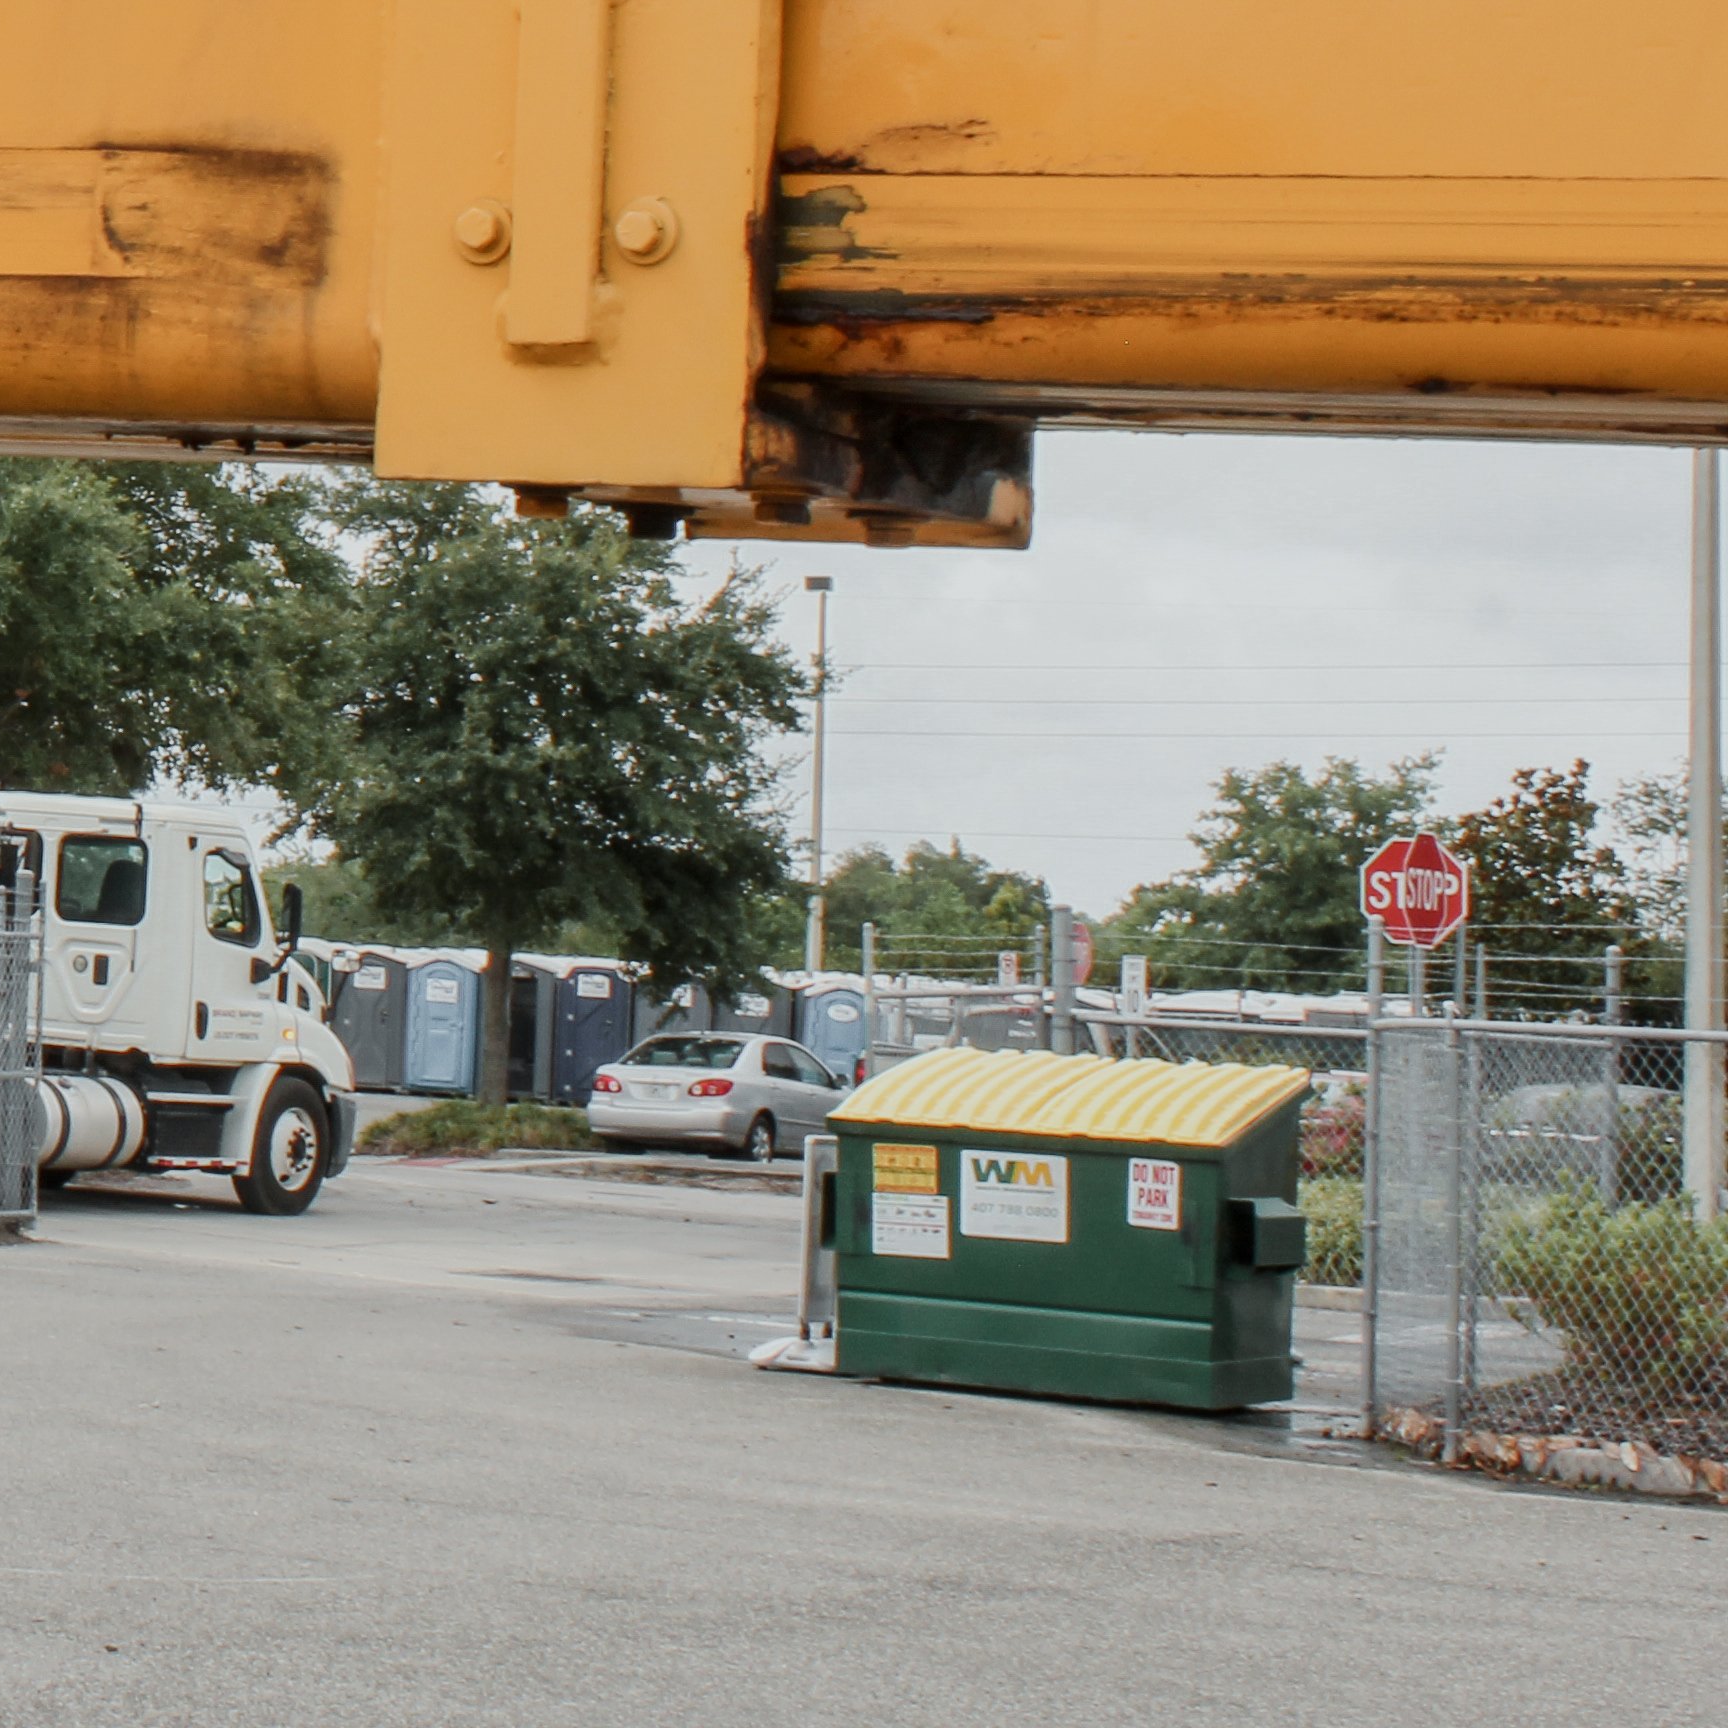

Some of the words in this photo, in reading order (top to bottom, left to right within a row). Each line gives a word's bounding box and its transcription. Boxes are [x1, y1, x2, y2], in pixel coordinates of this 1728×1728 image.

[1368, 869, 1459, 910] STP
[1407, 867, 1444, 911] STOP
[971, 1158, 1055, 1186] WM
[1133, 1163, 1148, 1183] DO
[1152, 1165, 1176, 1185] NOT
[1137, 1187, 1170, 1208] PARK
